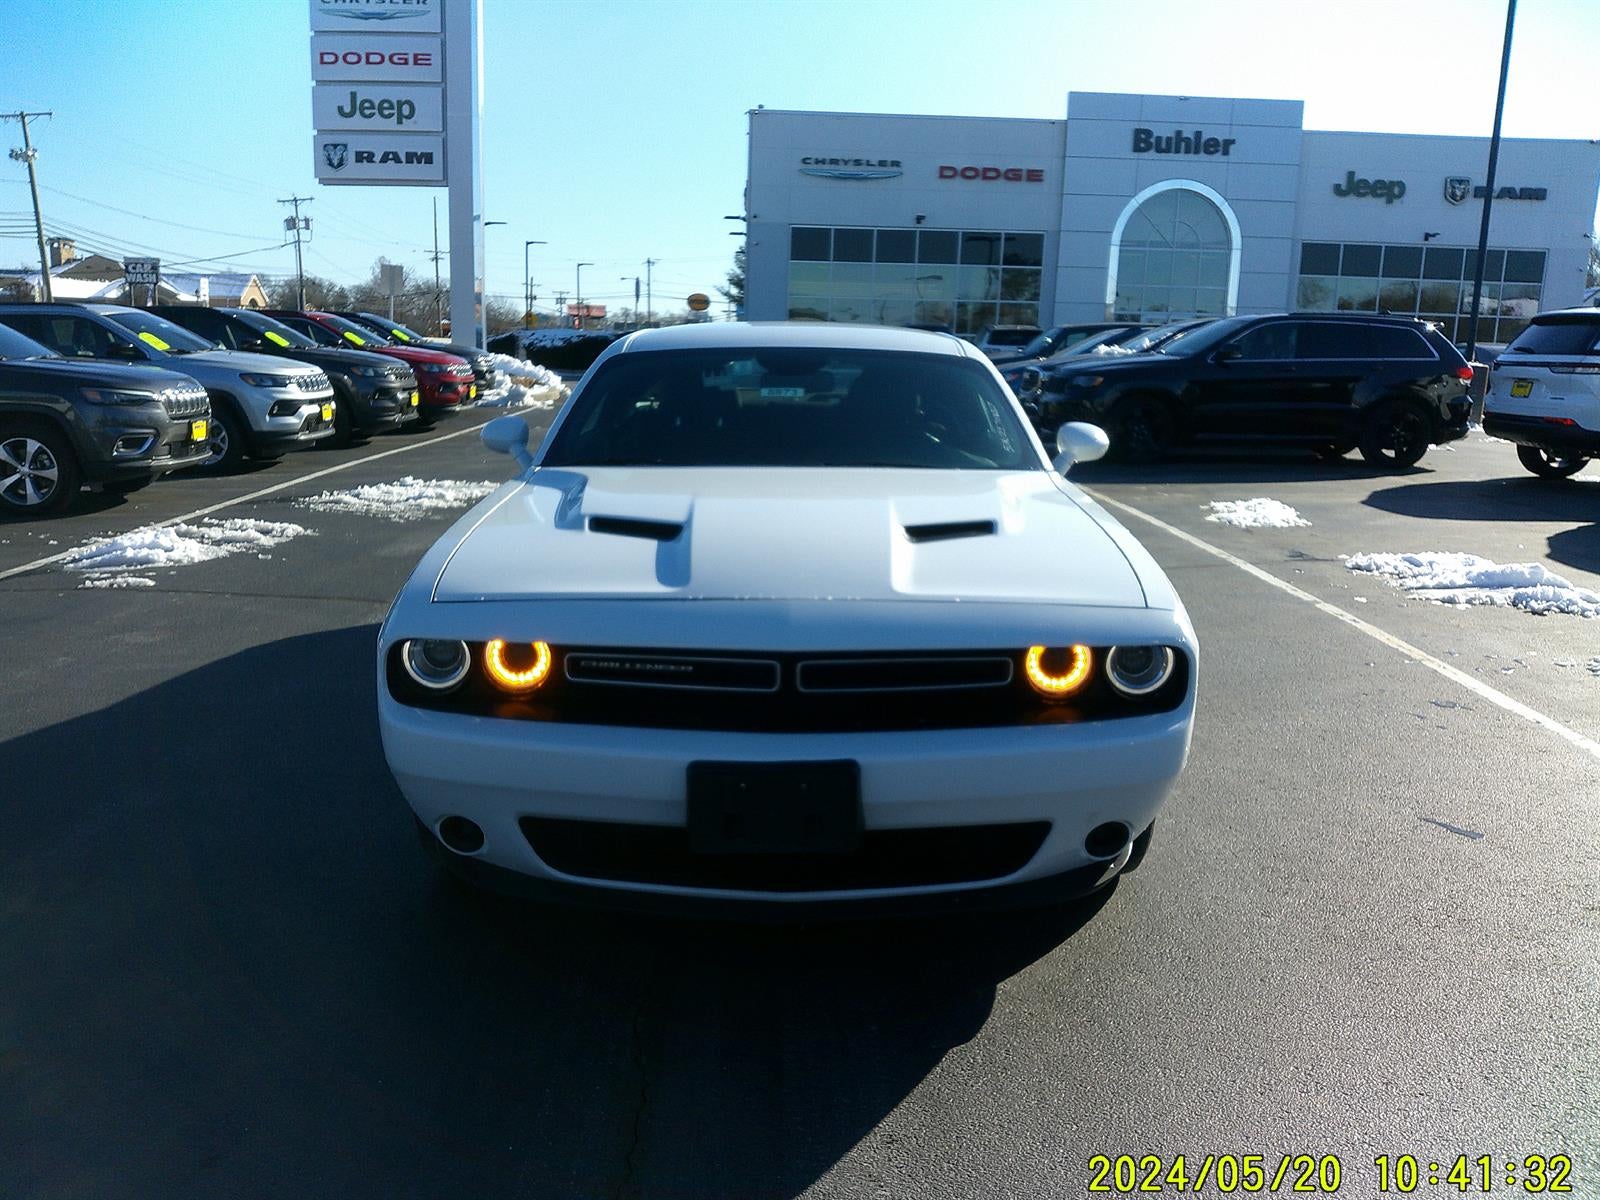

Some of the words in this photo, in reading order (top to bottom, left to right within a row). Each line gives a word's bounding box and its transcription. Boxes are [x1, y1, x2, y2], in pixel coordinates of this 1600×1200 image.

[319, 52, 432, 66] DODGE
[337, 91, 417, 125] Jeep
[1132, 128, 1236, 156] Buhler
[354, 151, 434, 165] RAM
[801, 157, 902, 167] CHRYSLER
[939, 165, 1045, 183] DODGE
[1333, 171, 1407, 205] Jeep
[128, 263, 153, 273] CAR
[126, 273, 157, 283] WASH
